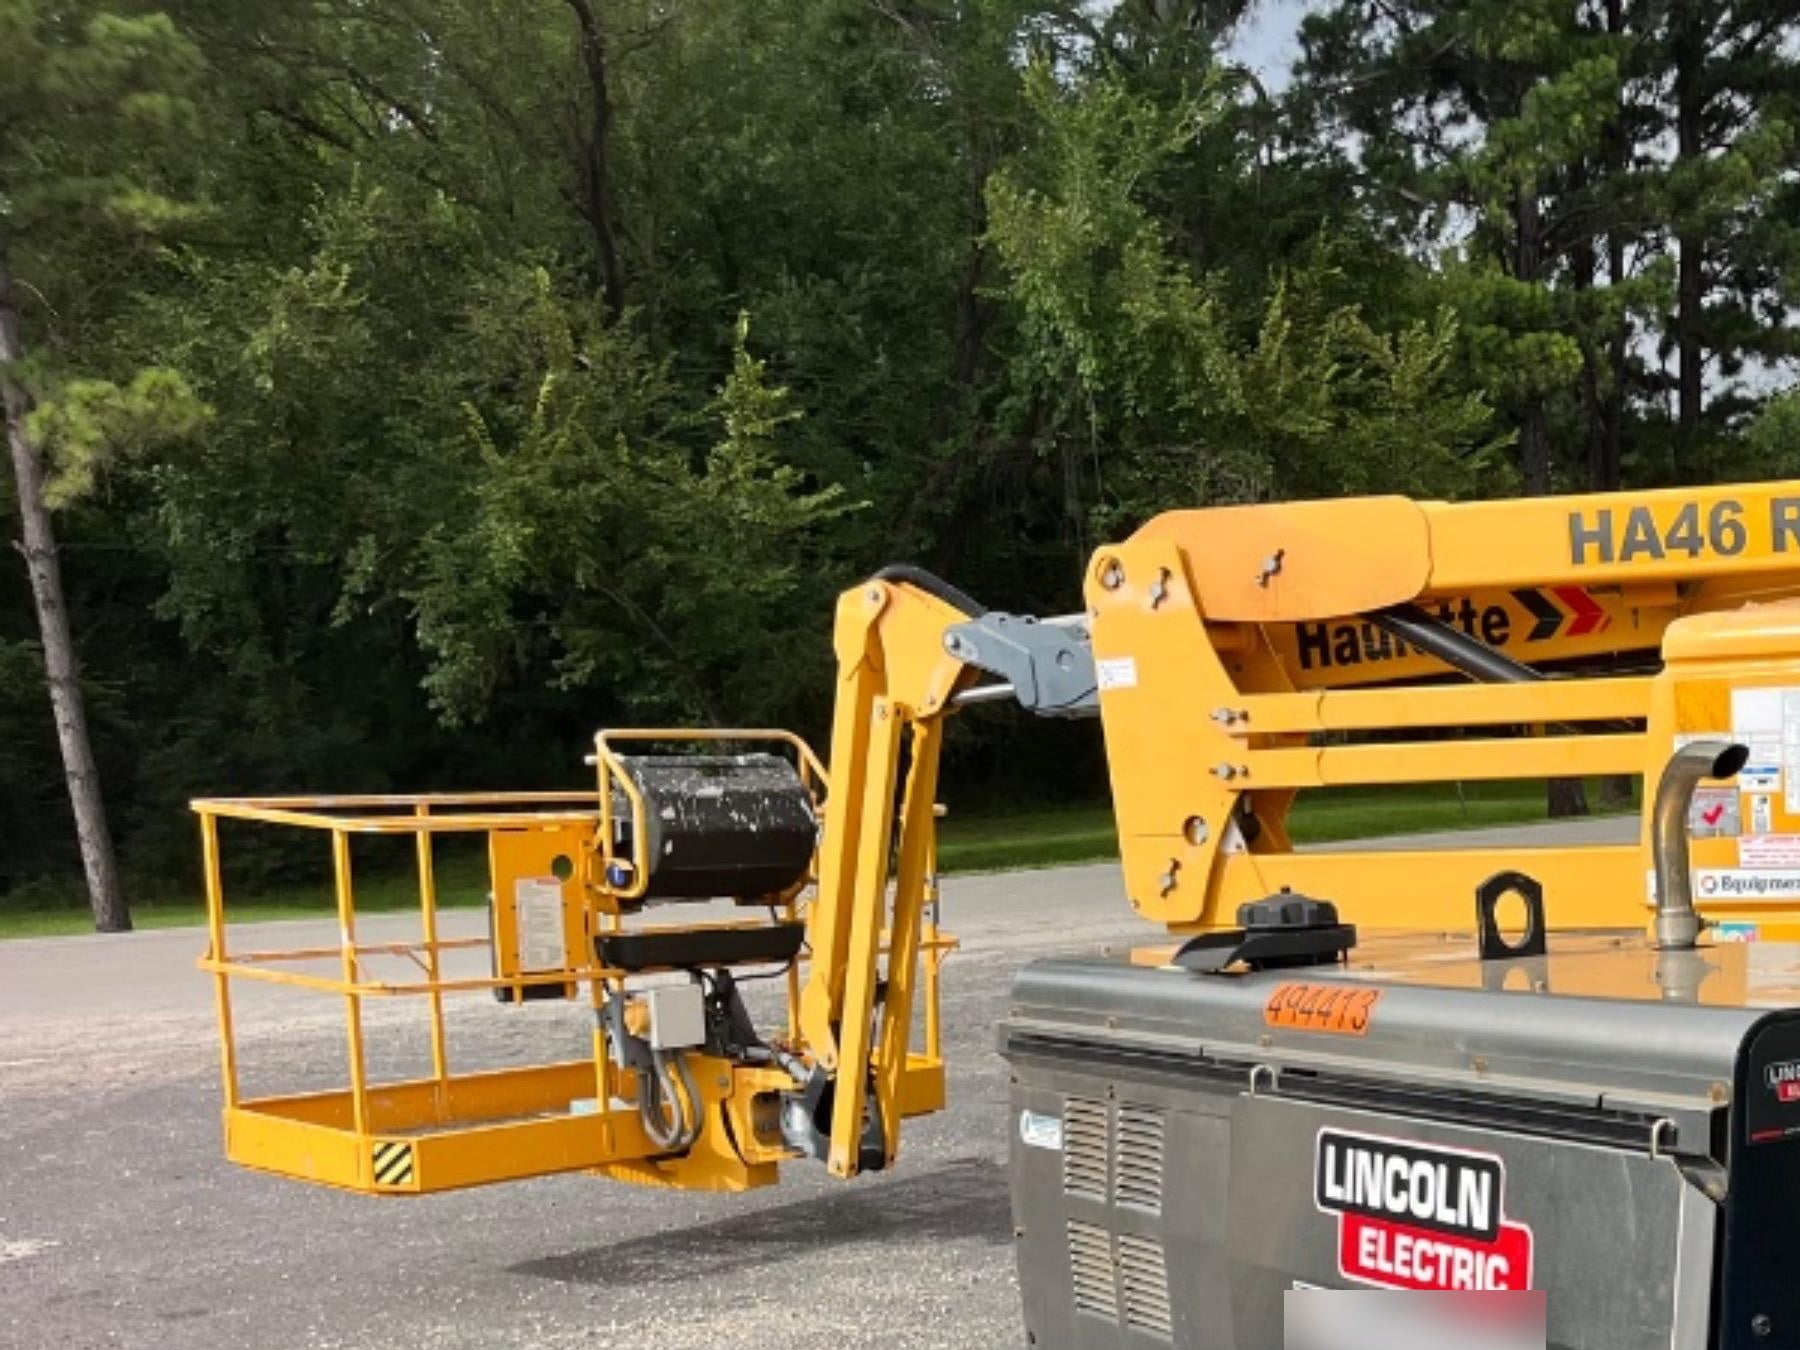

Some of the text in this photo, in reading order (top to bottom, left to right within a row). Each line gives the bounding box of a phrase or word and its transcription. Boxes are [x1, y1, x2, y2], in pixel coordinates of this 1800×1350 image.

[1568, 499, 1748, 564] HA46
[1267, 985, 1380, 1031] 494413
[1323, 1143, 1491, 1231] LINCOLN
[1358, 1225, 1509, 1290] ELECTRIC
